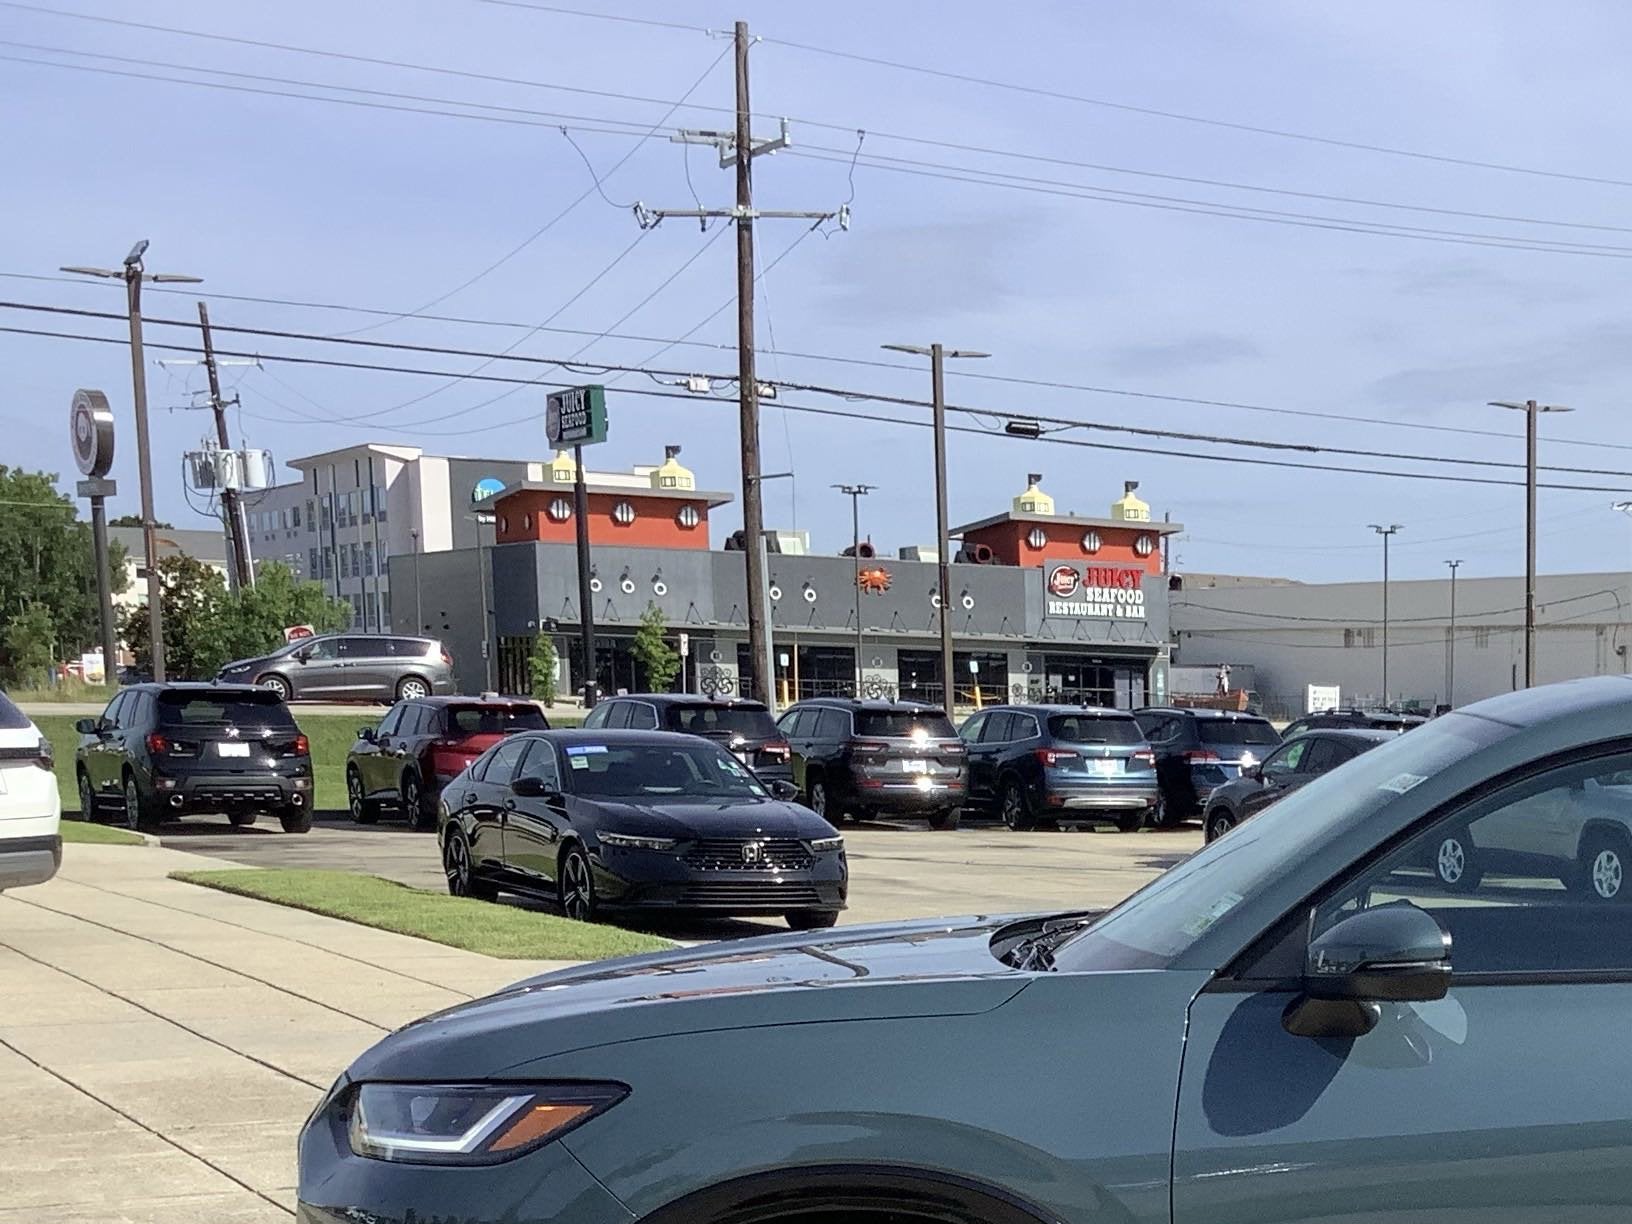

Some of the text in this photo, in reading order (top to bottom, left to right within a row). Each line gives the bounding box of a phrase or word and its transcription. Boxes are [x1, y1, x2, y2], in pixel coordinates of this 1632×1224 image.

[561, 389, 586, 415] JUICY
[1082, 567, 1144, 588] JUICY
[1086, 587, 1144, 604] SEAFOOD
[1048, 601, 1114, 617] RESTAURANT
[1125, 605, 1145, 618] BAR
